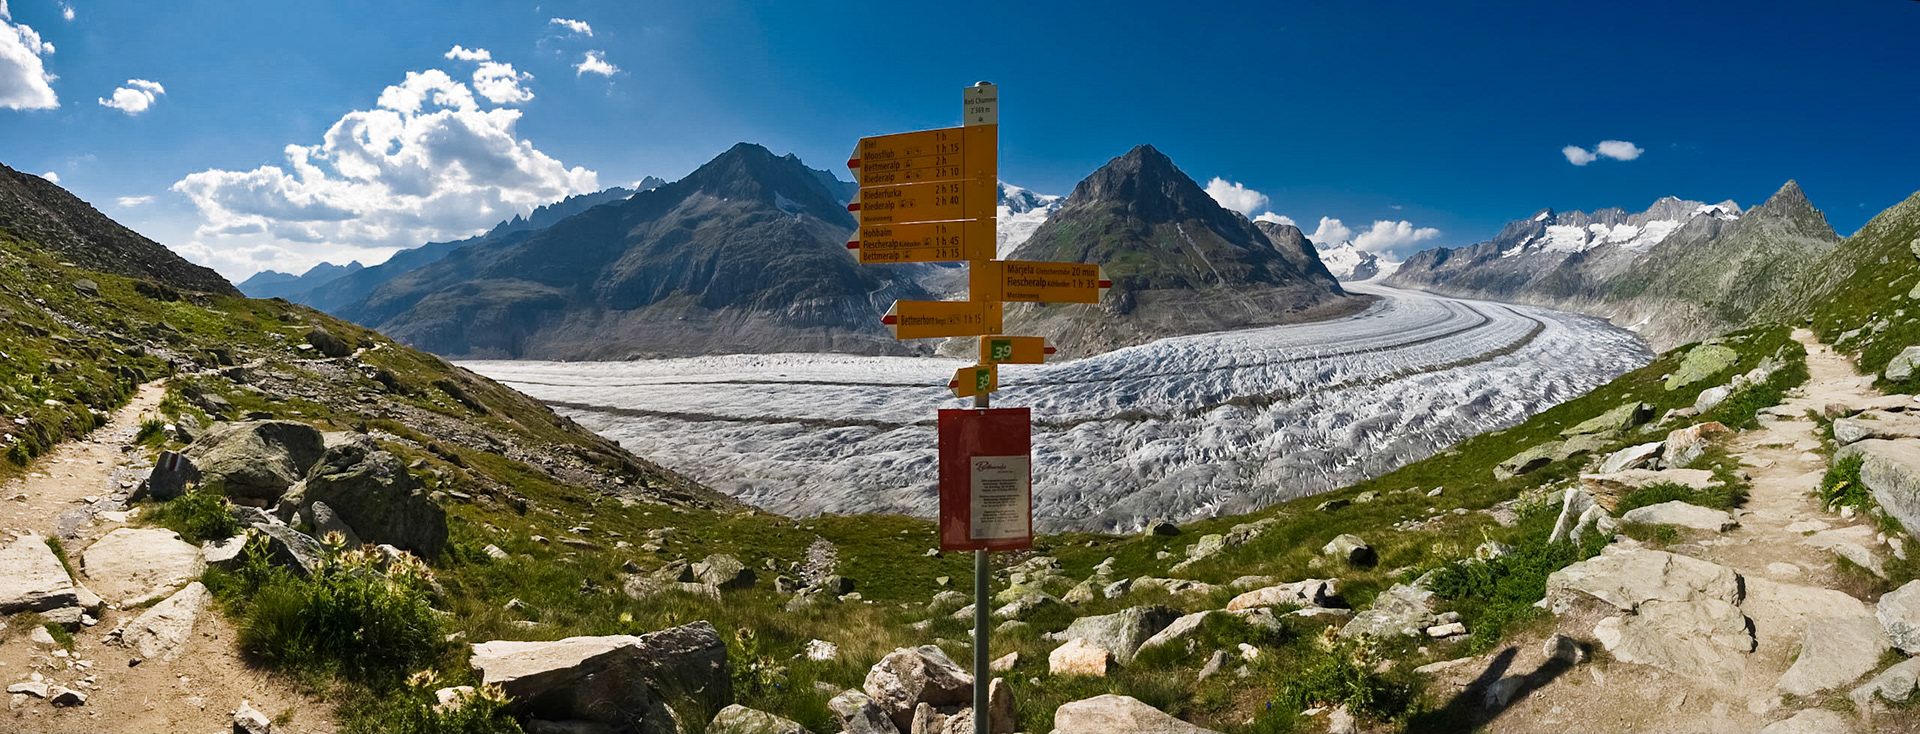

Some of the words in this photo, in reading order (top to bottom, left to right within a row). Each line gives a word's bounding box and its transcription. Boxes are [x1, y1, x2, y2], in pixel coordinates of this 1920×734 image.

[864, 140, 876, 149] Biel
[942, 133, 946, 141] h
[864, 150, 894, 160] Moosfluh
[936, 144, 939, 153] 1
[942, 144, 946, 152] h
[951, 143, 959, 152] 15
[864, 160, 900, 172] Bettmeralp
[936, 157, 939, 165] 2
[942, 156, 946, 165] h
[864, 173, 894, 183] Riederalp
[936, 169, 939, 177] 2
[942, 168, 946, 177] h
[951, 168, 958, 176] 10
[864, 189, 901, 200] Riederfurka
[936, 186, 939, 194] 2
[951, 184, 958, 193] 15
[864, 201, 894, 211] Riederalp
[936, 197, 939, 206] 2
[942, 197, 946, 205] h
[950, 196, 958, 205] 40
[864, 228, 892, 237] Hohbalm
[864, 240, 899, 249] Fiescheralp
[942, 237, 946, 245] h
[950, 236, 958, 245] 45
[864, 251, 899, 261] Bettmeralp
[936, 250, 940, 258] 2
[942, 249, 946, 257] h
[951, 249, 959, 258] 15
[1072, 267, 1080, 276] 20
[1082, 268, 1095, 276] min
[1007, 277, 1046, 289] Fiescheralp
[1073, 280, 1075, 288] 1
[1078, 280, 1083, 288] h
[901, 314, 934, 326] Bettmerhorn
[964, 315, 967, 324] 1
[969, 314, 972, 324] h
[975, 314, 981, 323] 15
[994, 345, 1011, 359] 39
[979, 374, 990, 389] 39
